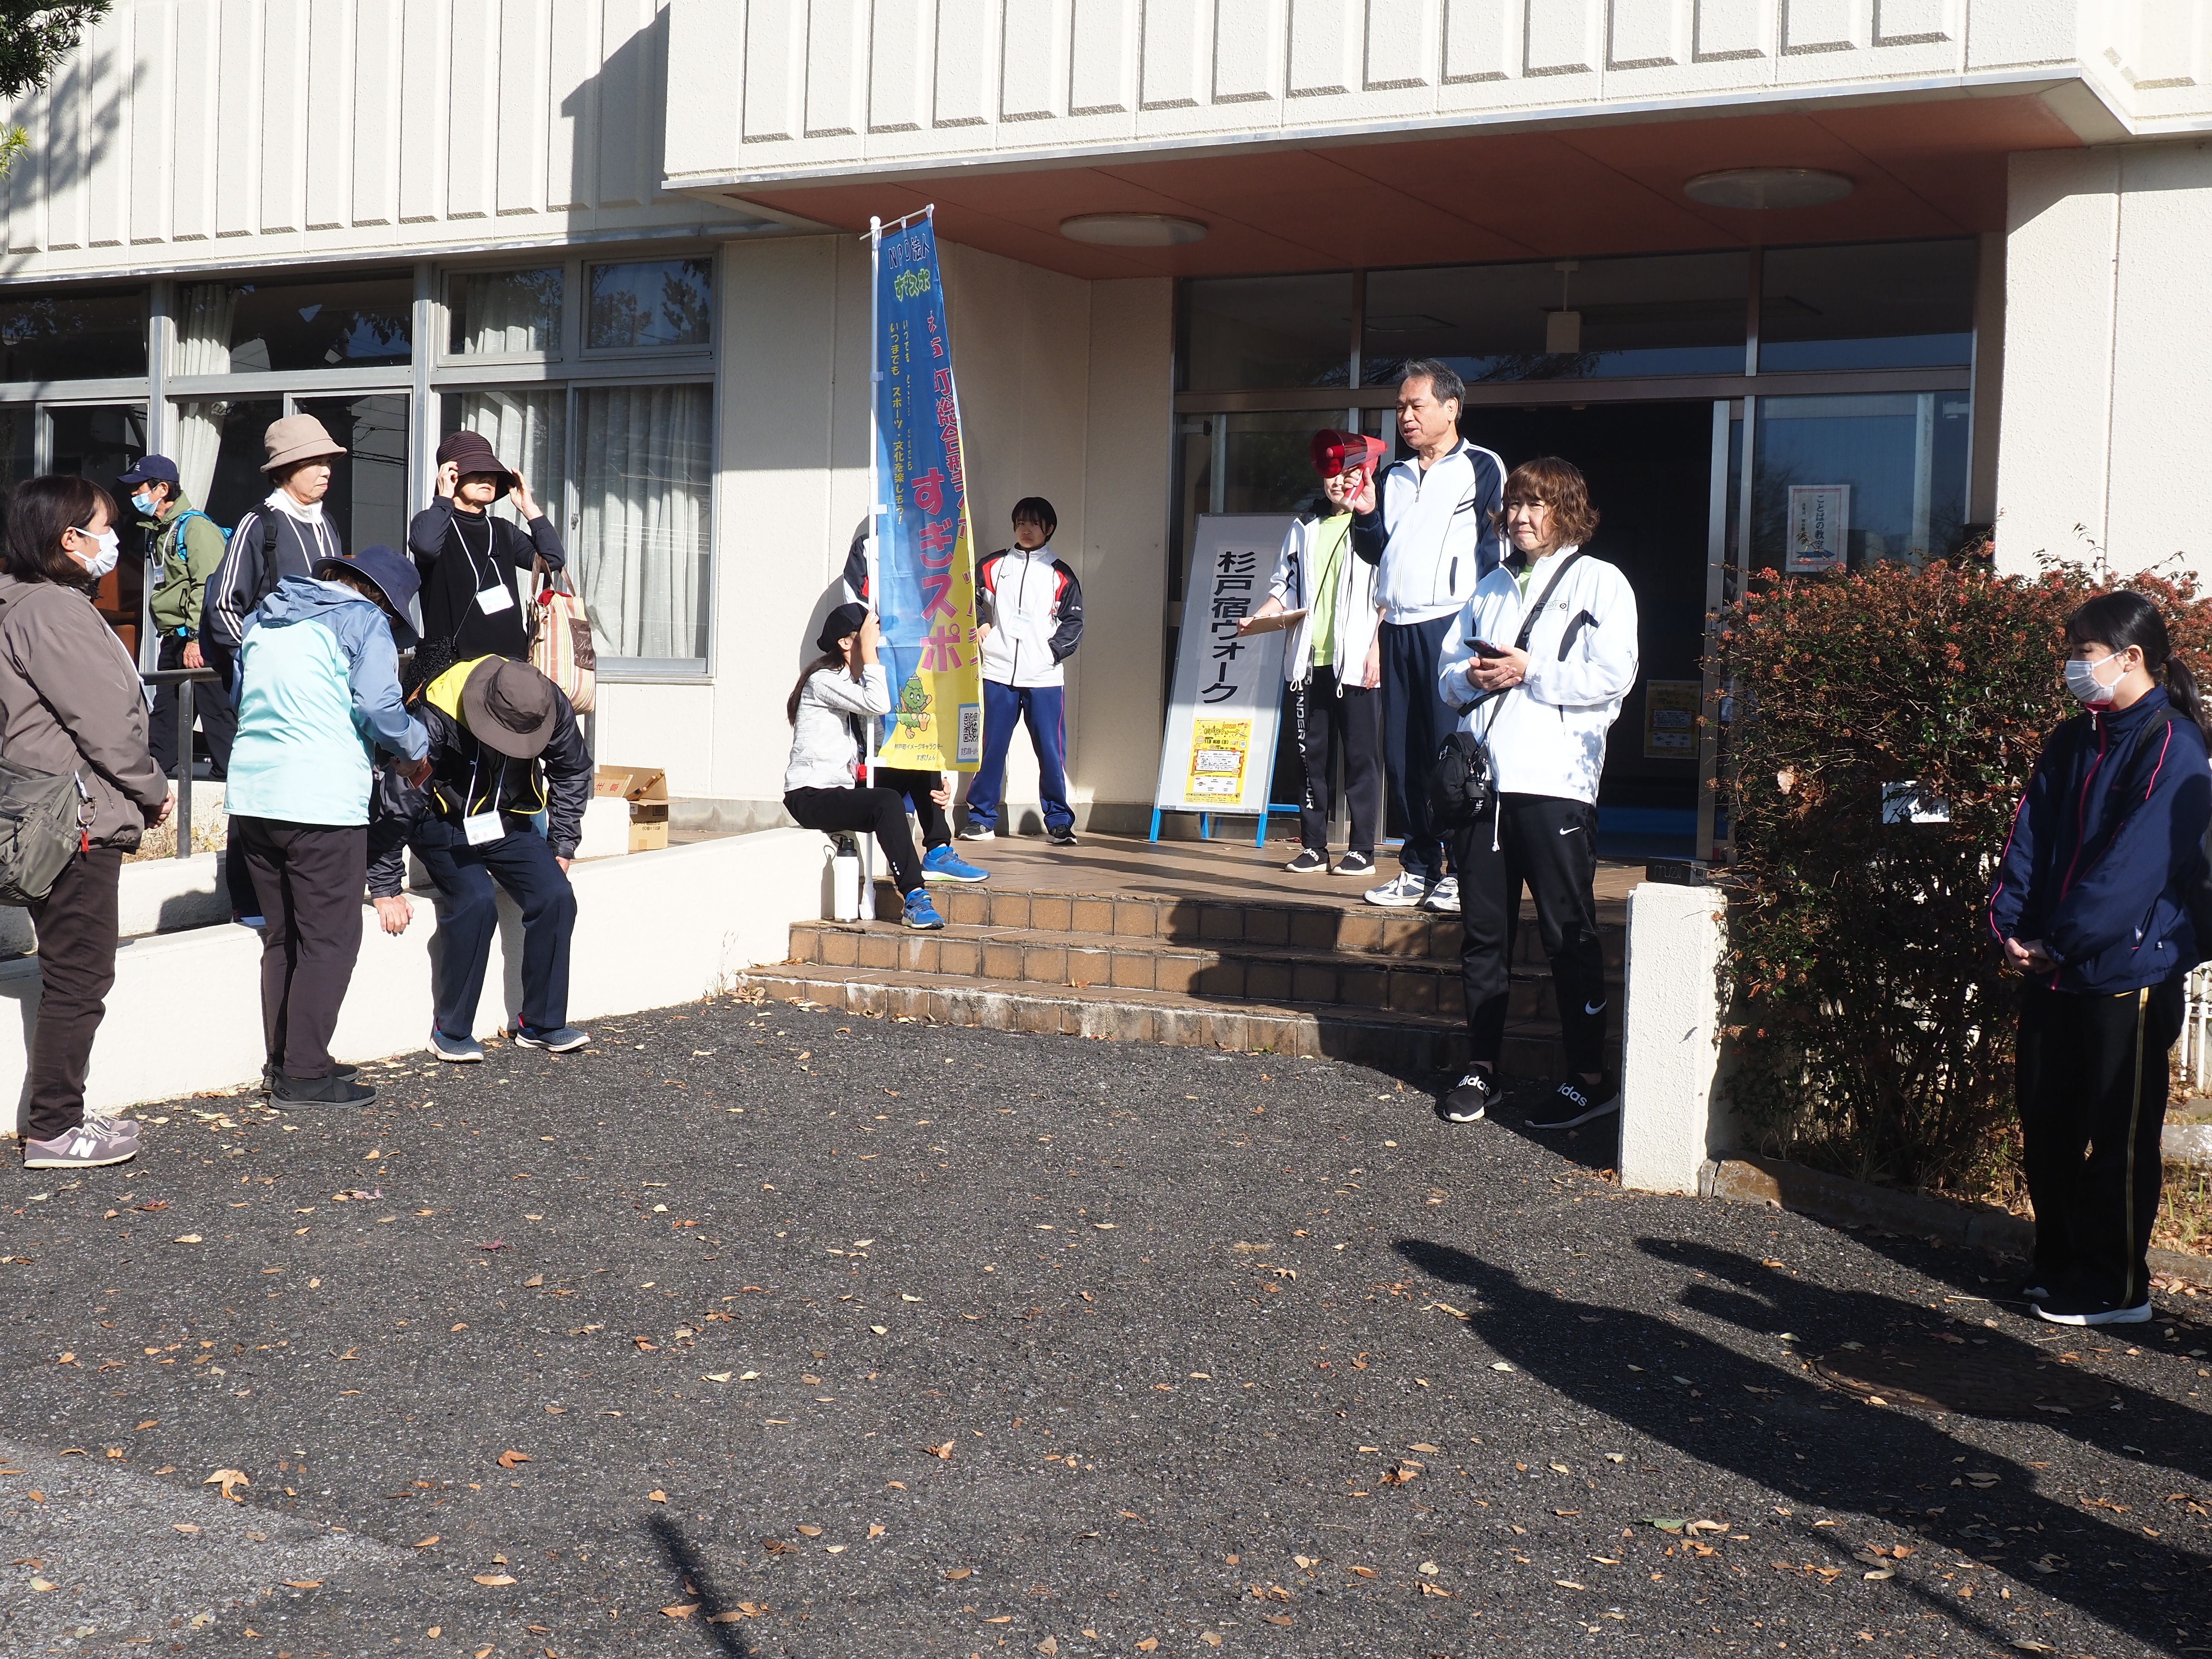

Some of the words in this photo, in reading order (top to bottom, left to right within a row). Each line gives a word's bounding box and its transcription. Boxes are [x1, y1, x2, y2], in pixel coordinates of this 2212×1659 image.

[888, 233, 930, 269] NPO法人
[890, 322, 900, 375] いつまでも
[1814, 495, 1825, 549] ことばの教室
[911, 467, 962, 673] すぎスポ
[1201, 551, 1256, 704] 杉戸宿ウォーク
[1456, 1075, 1490, 1097] didas
[1557, 1083, 1587, 1107] idas
